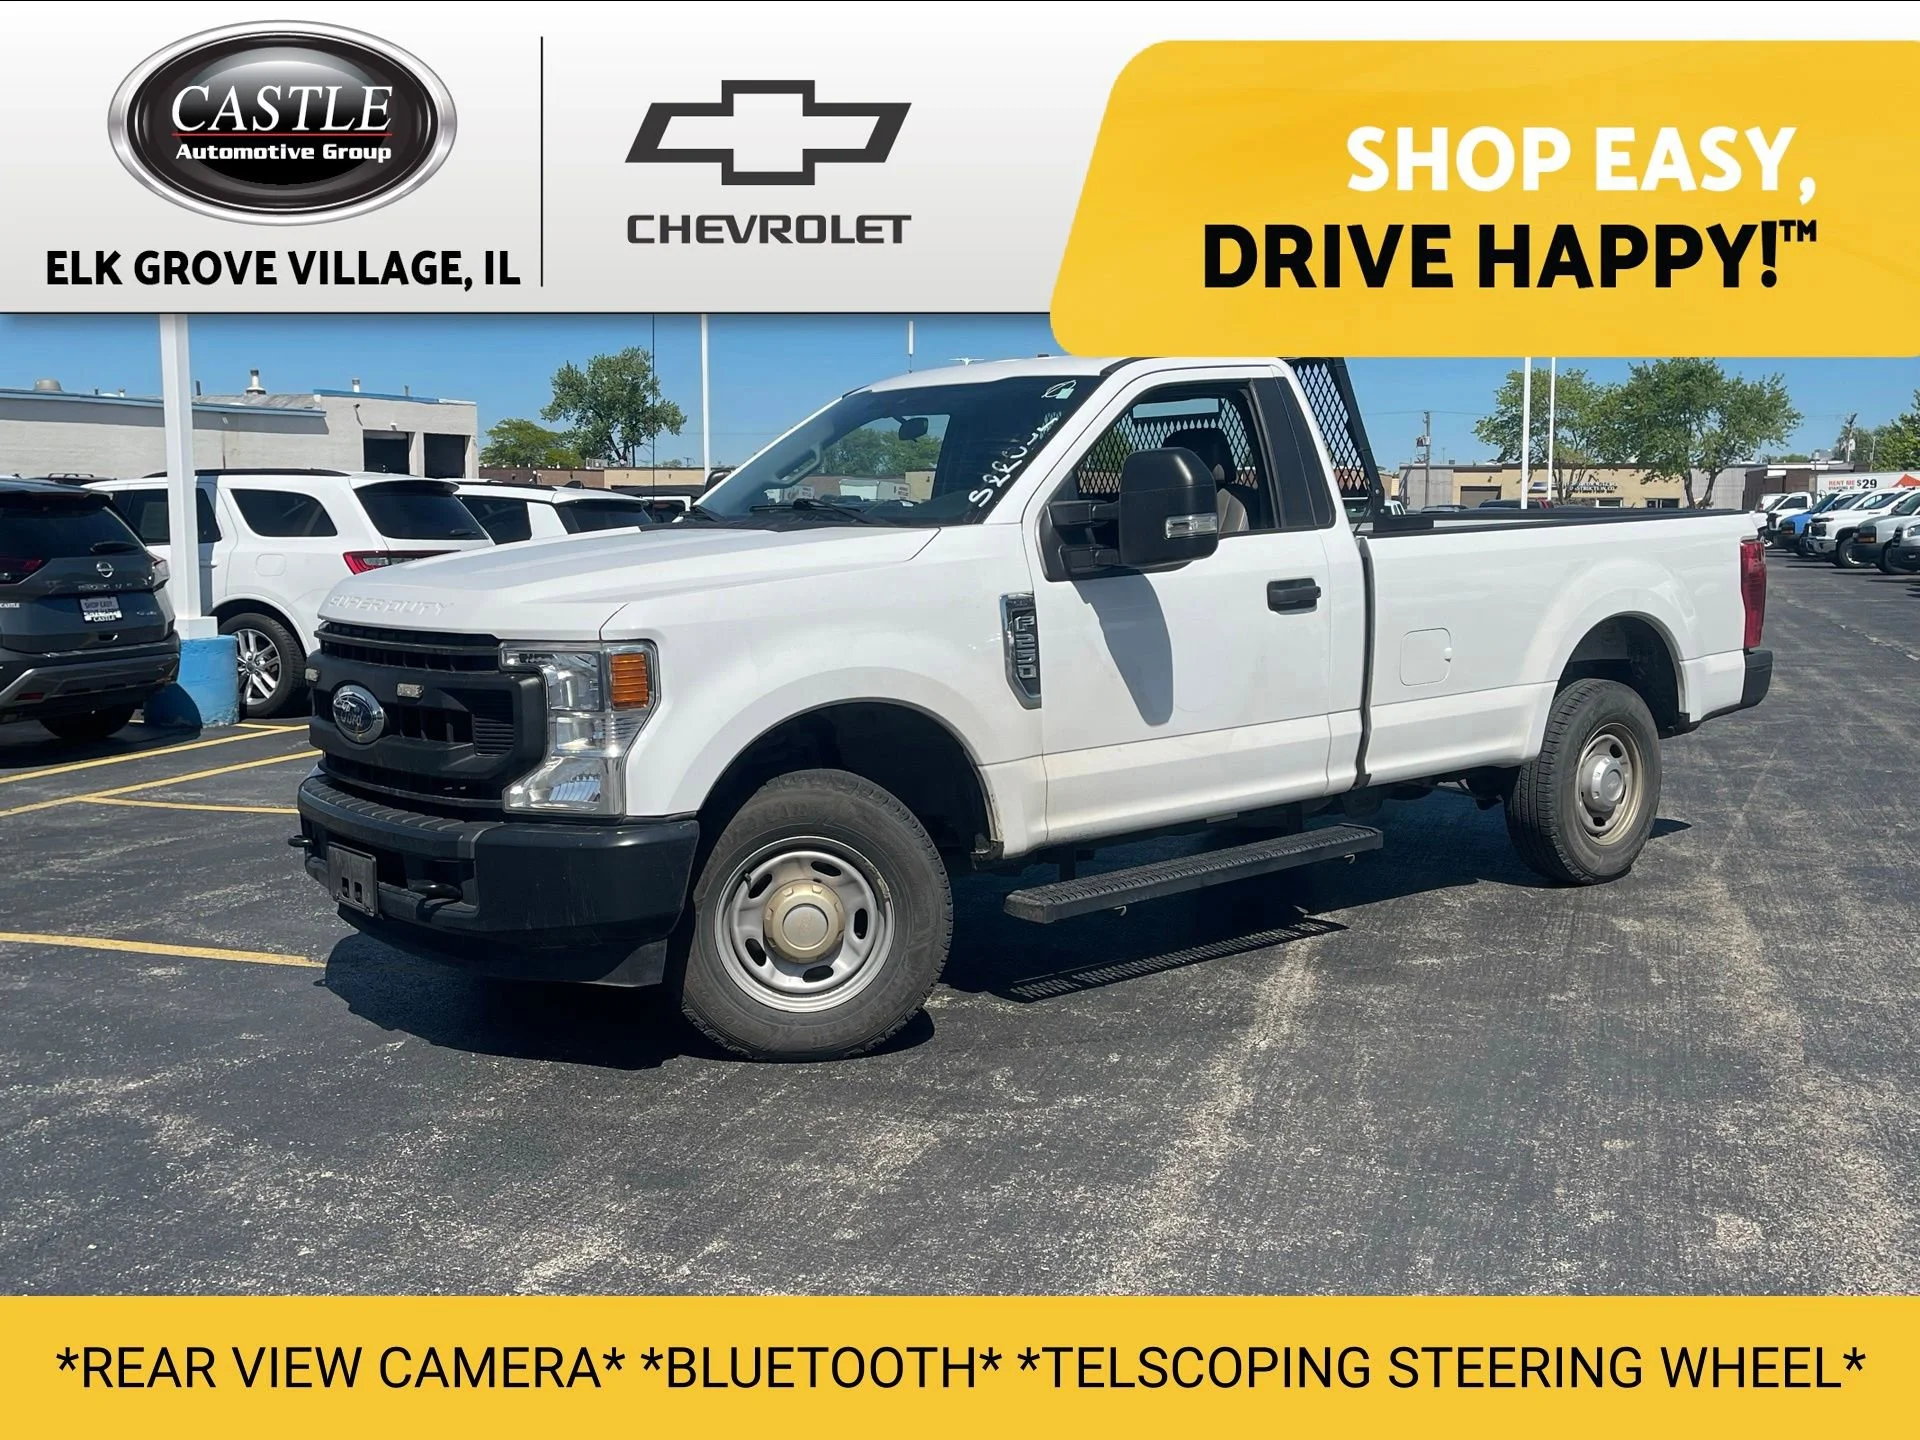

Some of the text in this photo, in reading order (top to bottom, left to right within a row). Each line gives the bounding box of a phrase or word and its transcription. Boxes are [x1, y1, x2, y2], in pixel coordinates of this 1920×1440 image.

[1828, 479, 1845, 487] RENT
[1856, 478, 1878, 489] $29
[329, 594, 447, 617] SUPER DUTY
